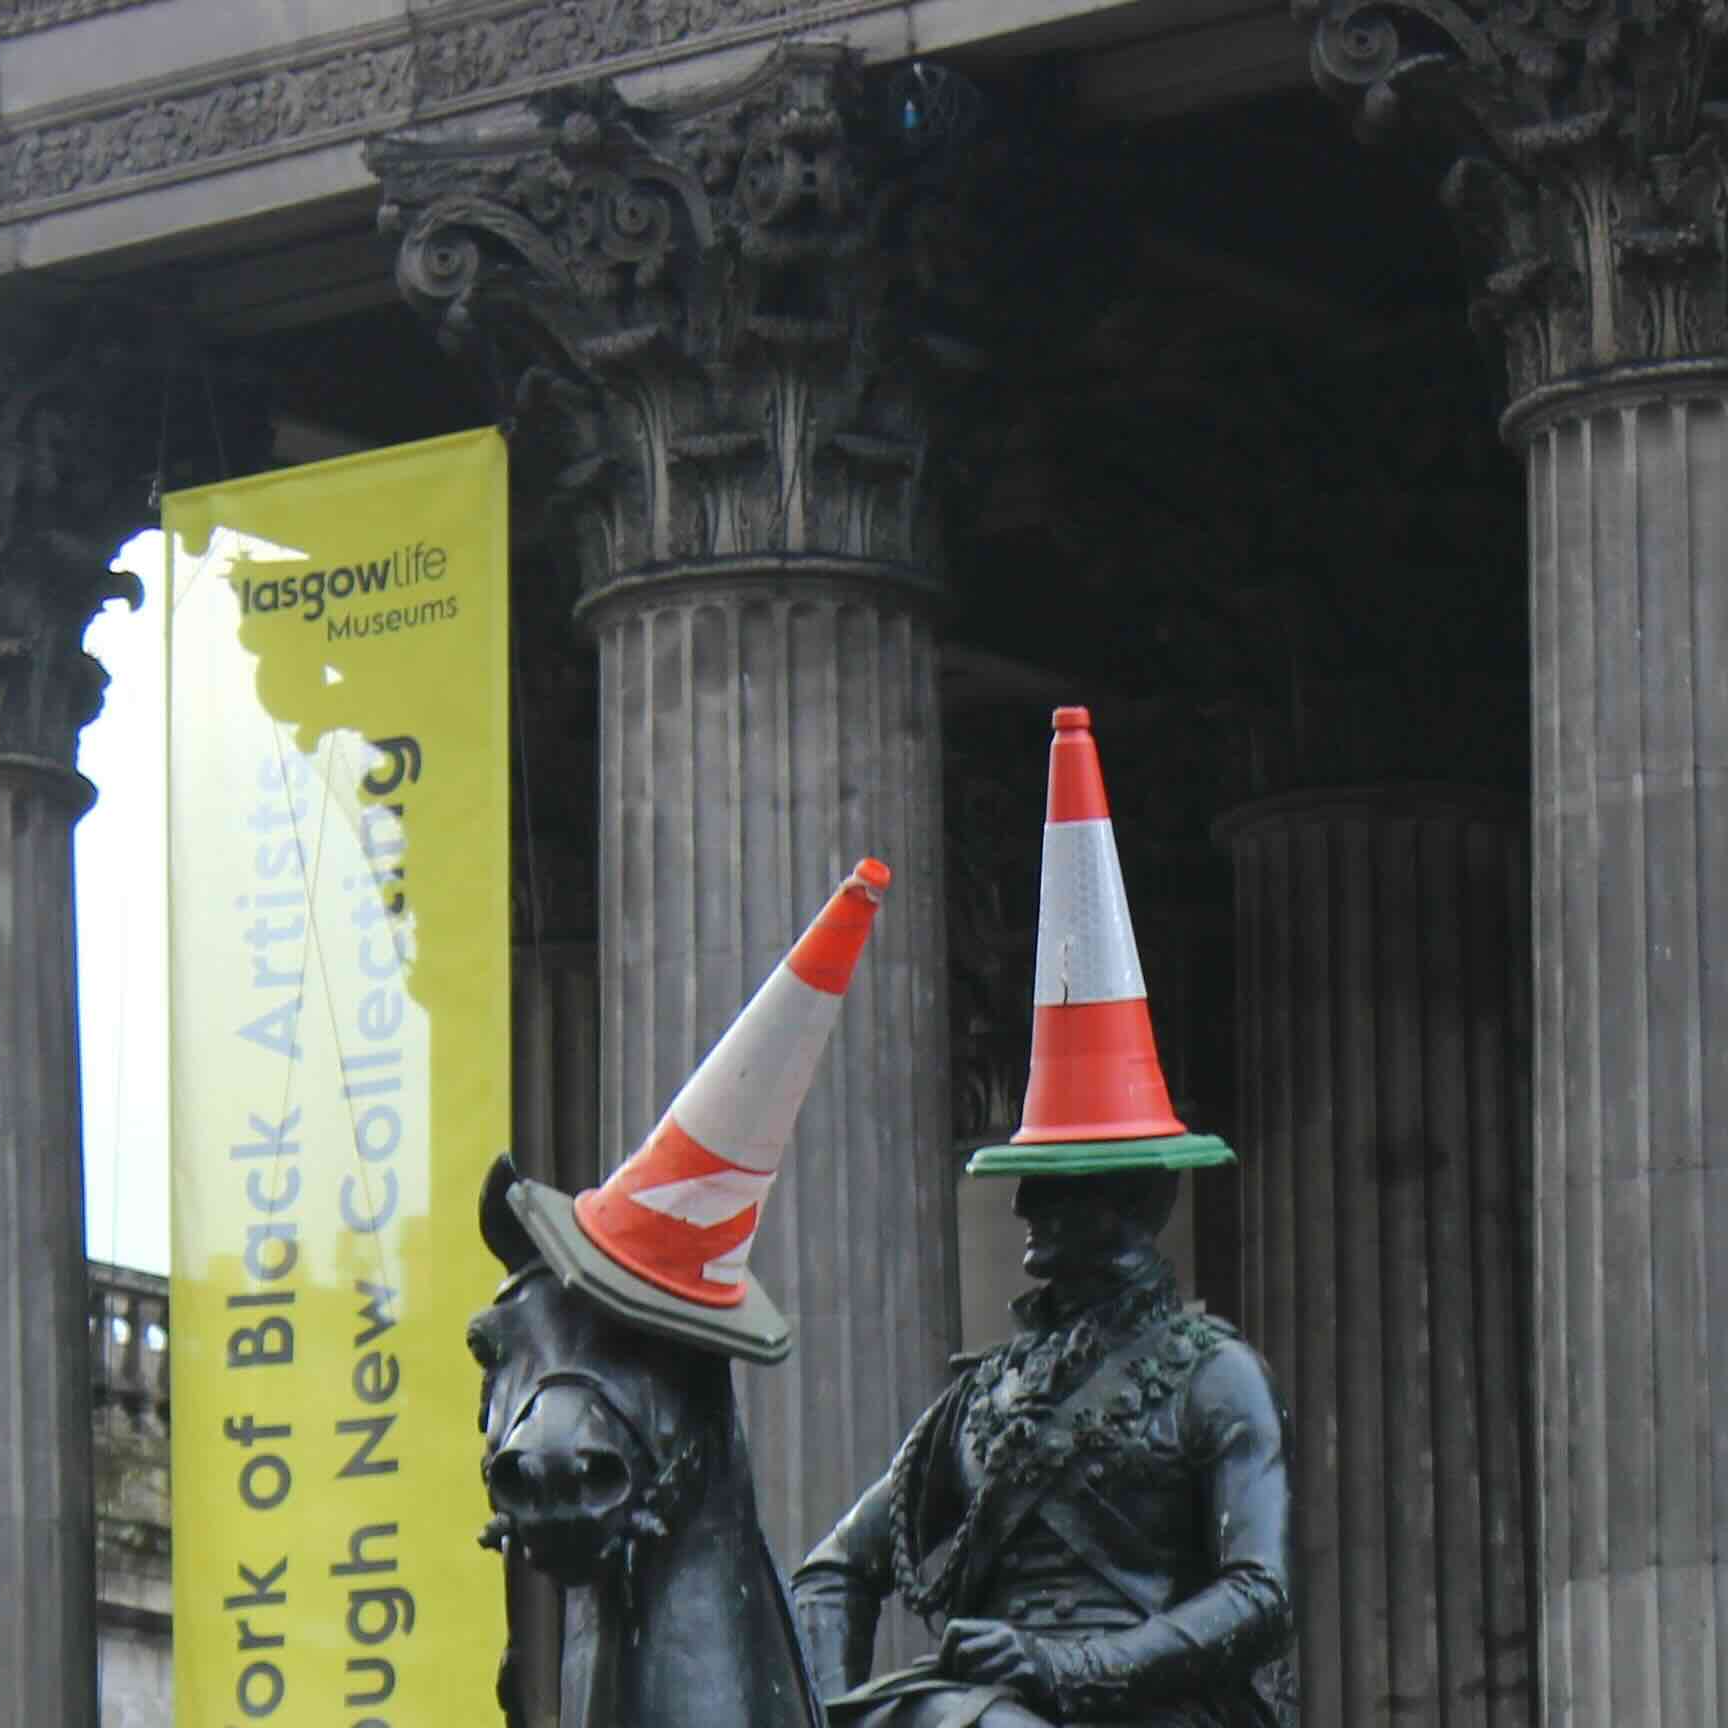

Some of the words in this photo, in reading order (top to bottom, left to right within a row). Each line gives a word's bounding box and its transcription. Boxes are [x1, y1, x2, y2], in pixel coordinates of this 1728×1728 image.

[327, 594, 458, 641] Museums
[234, 752, 309, 1063] Artists
[338, 735, 422, 1233] Collecting
[226, 1104, 302, 1369] Black
[223, 1415, 292, 1512] of
[334, 1280, 399, 1480] New
